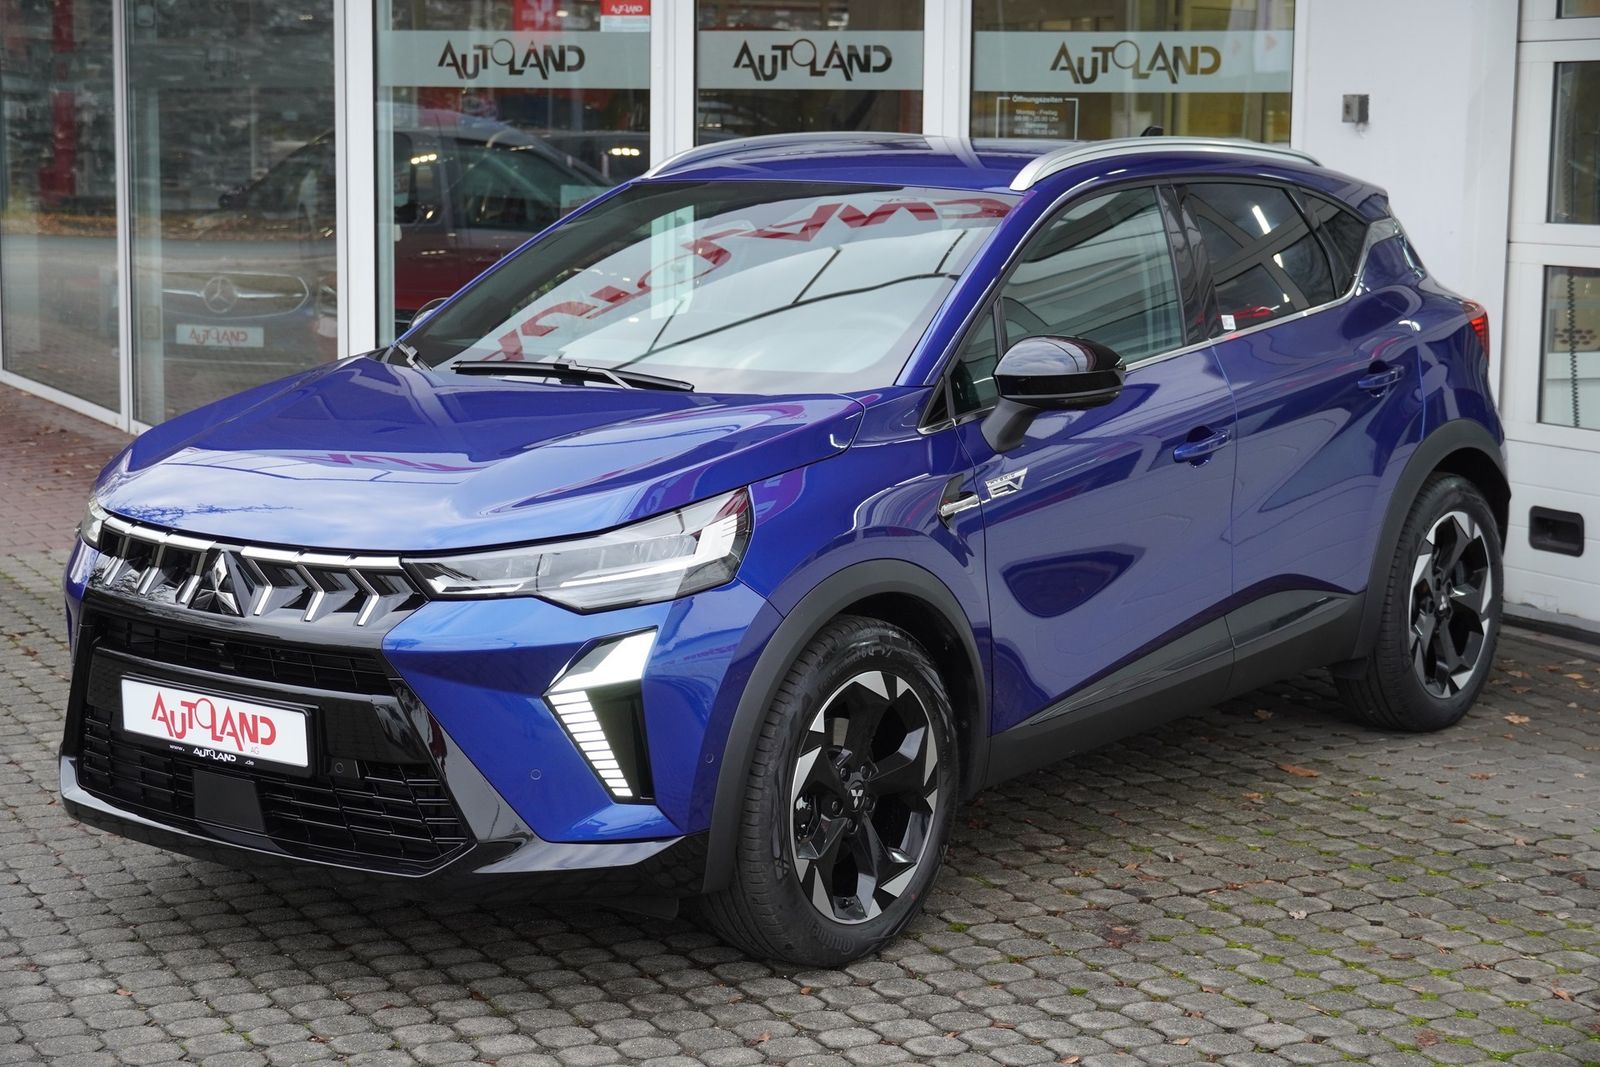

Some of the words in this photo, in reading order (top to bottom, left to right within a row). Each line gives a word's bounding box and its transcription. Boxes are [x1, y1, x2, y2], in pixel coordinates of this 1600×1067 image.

[438, 38, 585, 80] AUTOLAND
[733, 38, 892, 81] AUTOLAND
[1050, 40, 1221, 84] AUTOLAND
[190, 327, 248, 345] AUTOLAND
[151, 691, 277, 751] AUTOLAND
[193, 747, 237, 762] AUTOLAND
